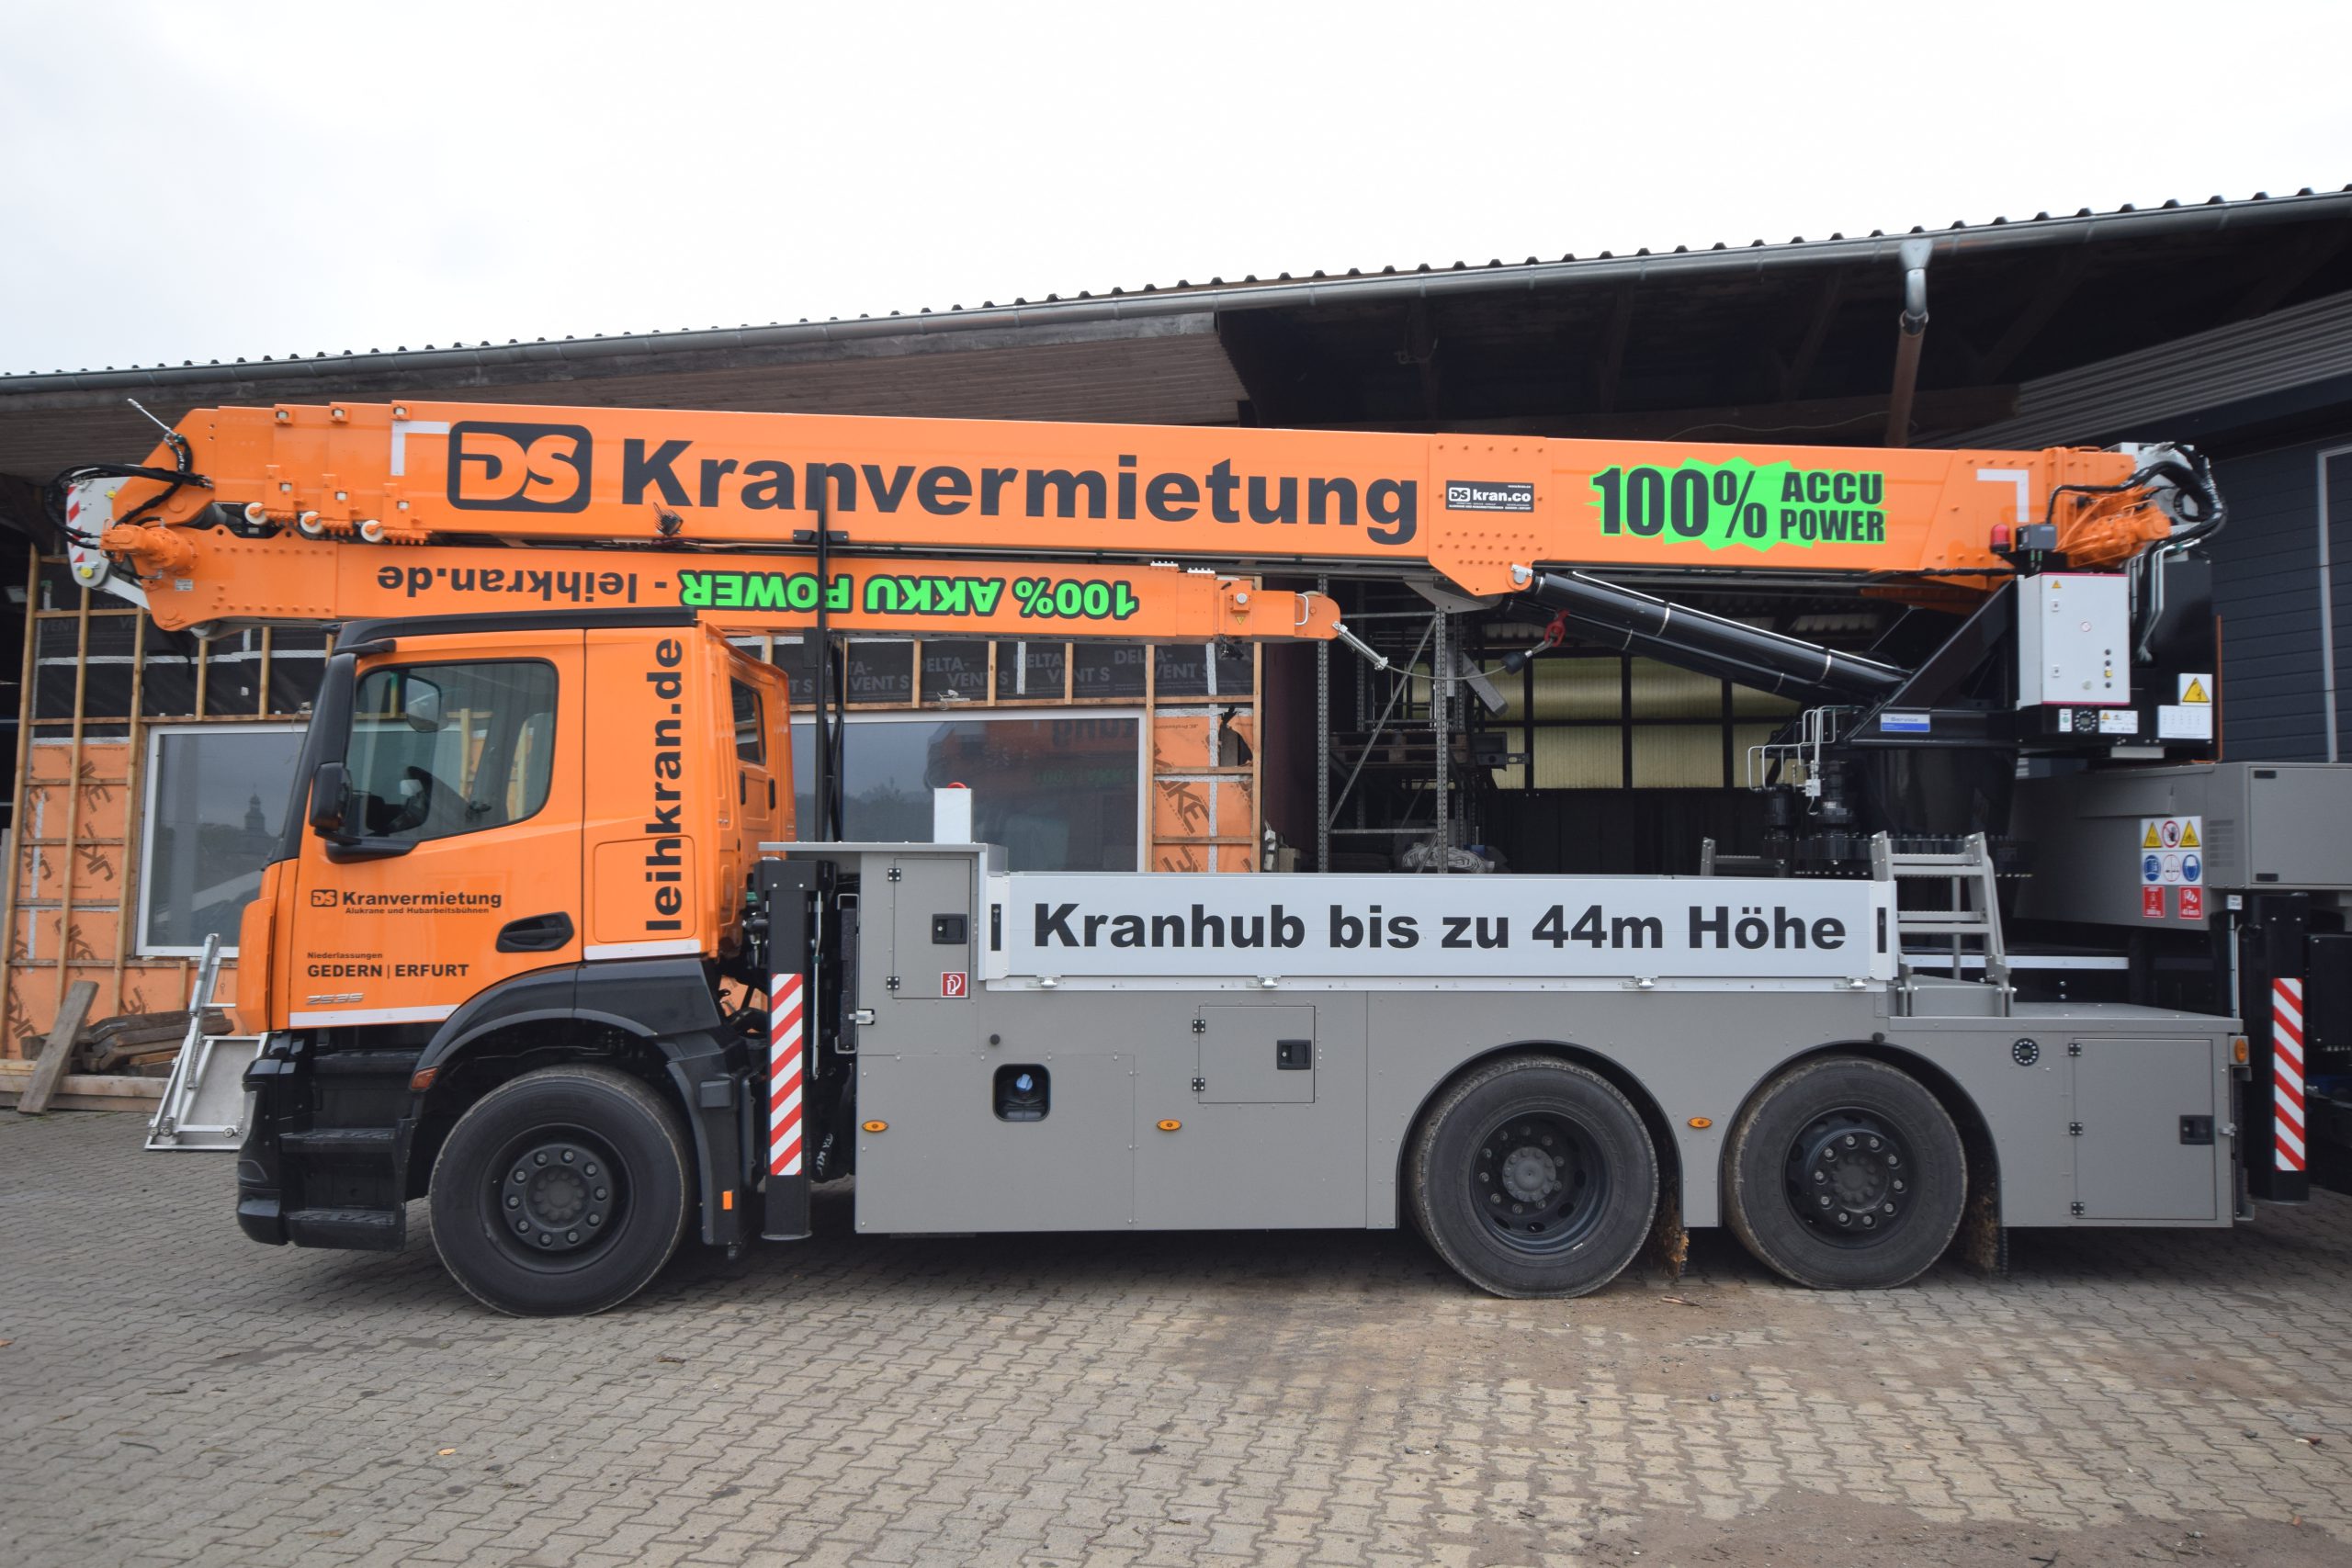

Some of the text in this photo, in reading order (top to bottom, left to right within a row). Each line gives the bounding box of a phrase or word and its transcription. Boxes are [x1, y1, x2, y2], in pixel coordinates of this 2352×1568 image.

[450, 423, 1418, 545] DS Kranvermietung
[1449, 487, 1532, 502] DS kran.co
[1592, 467, 1768, 538] 100%
[1781, 471, 1883, 504] ACCU
[1780, 509, 1884, 541] POWER
[377, 566, 637, 604] leihkran.de
[679, 569, 854, 614] POWER
[865, 572, 1006, 615] AKKU
[1012, 577, 1139, 619] 100%
[851, 674, 910, 691] VENT S
[645, 638, 683, 931] leihkran.de
[343, 891, 502, 908] Kranvermietung
[1035, 903, 1846, 950] Kranhub bis zu 44m Höhe
[307, 964, 383, 977] GEDERN
[395, 964, 469, 977] ERFURT
